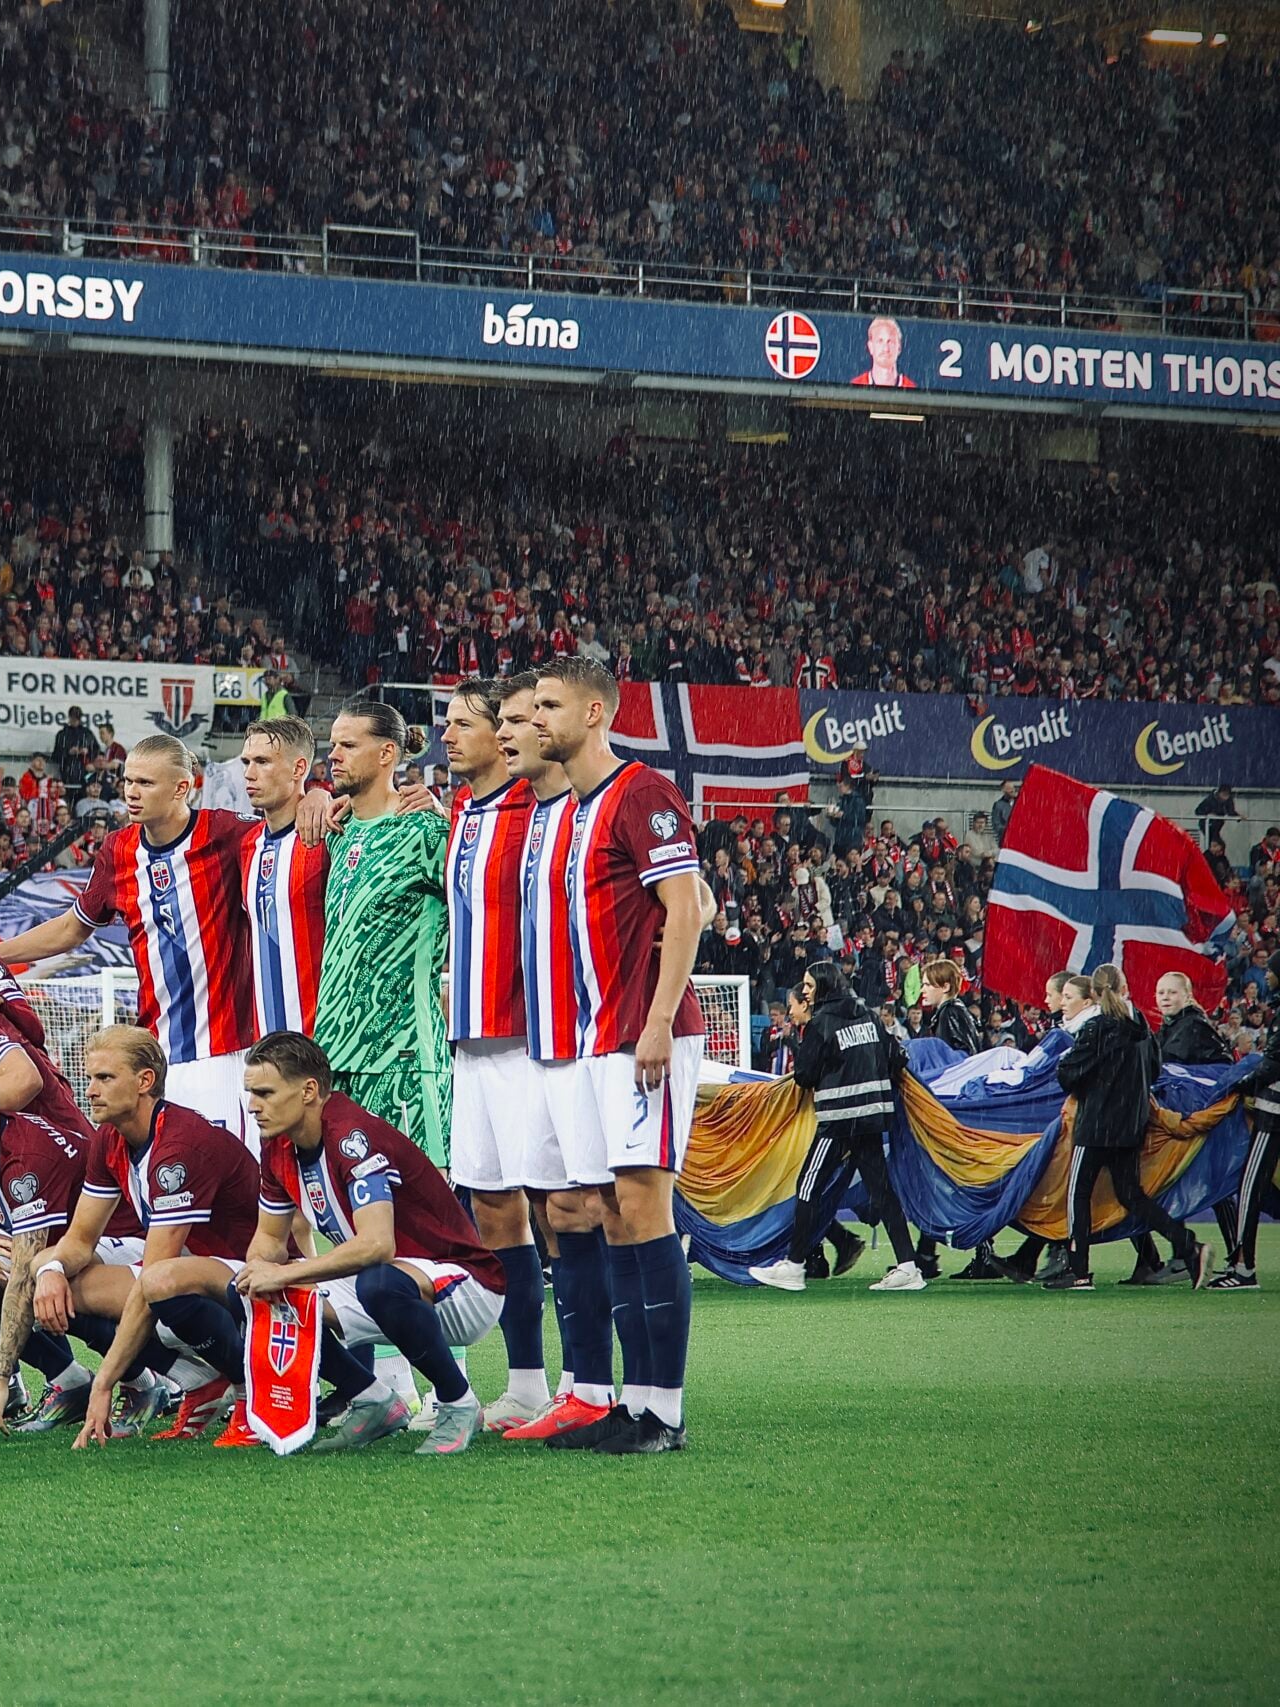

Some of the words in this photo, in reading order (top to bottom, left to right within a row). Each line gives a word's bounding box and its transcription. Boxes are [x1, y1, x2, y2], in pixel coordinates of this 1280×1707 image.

[938, 339, 964, 378] 2
[989, 341, 1152, 390] MORTEN
[1162, 353, 1280, 399] THORS
[7, 672, 56, 694] FOR
[68, 674, 148, 698] NORGE
[825, 700, 906, 750] Bendit
[992, 706, 1072, 756] Bendit
[1155, 713, 1234, 761] Bendit
[258, 895, 274, 934] 17
[353, 1179, 371, 1205] C
